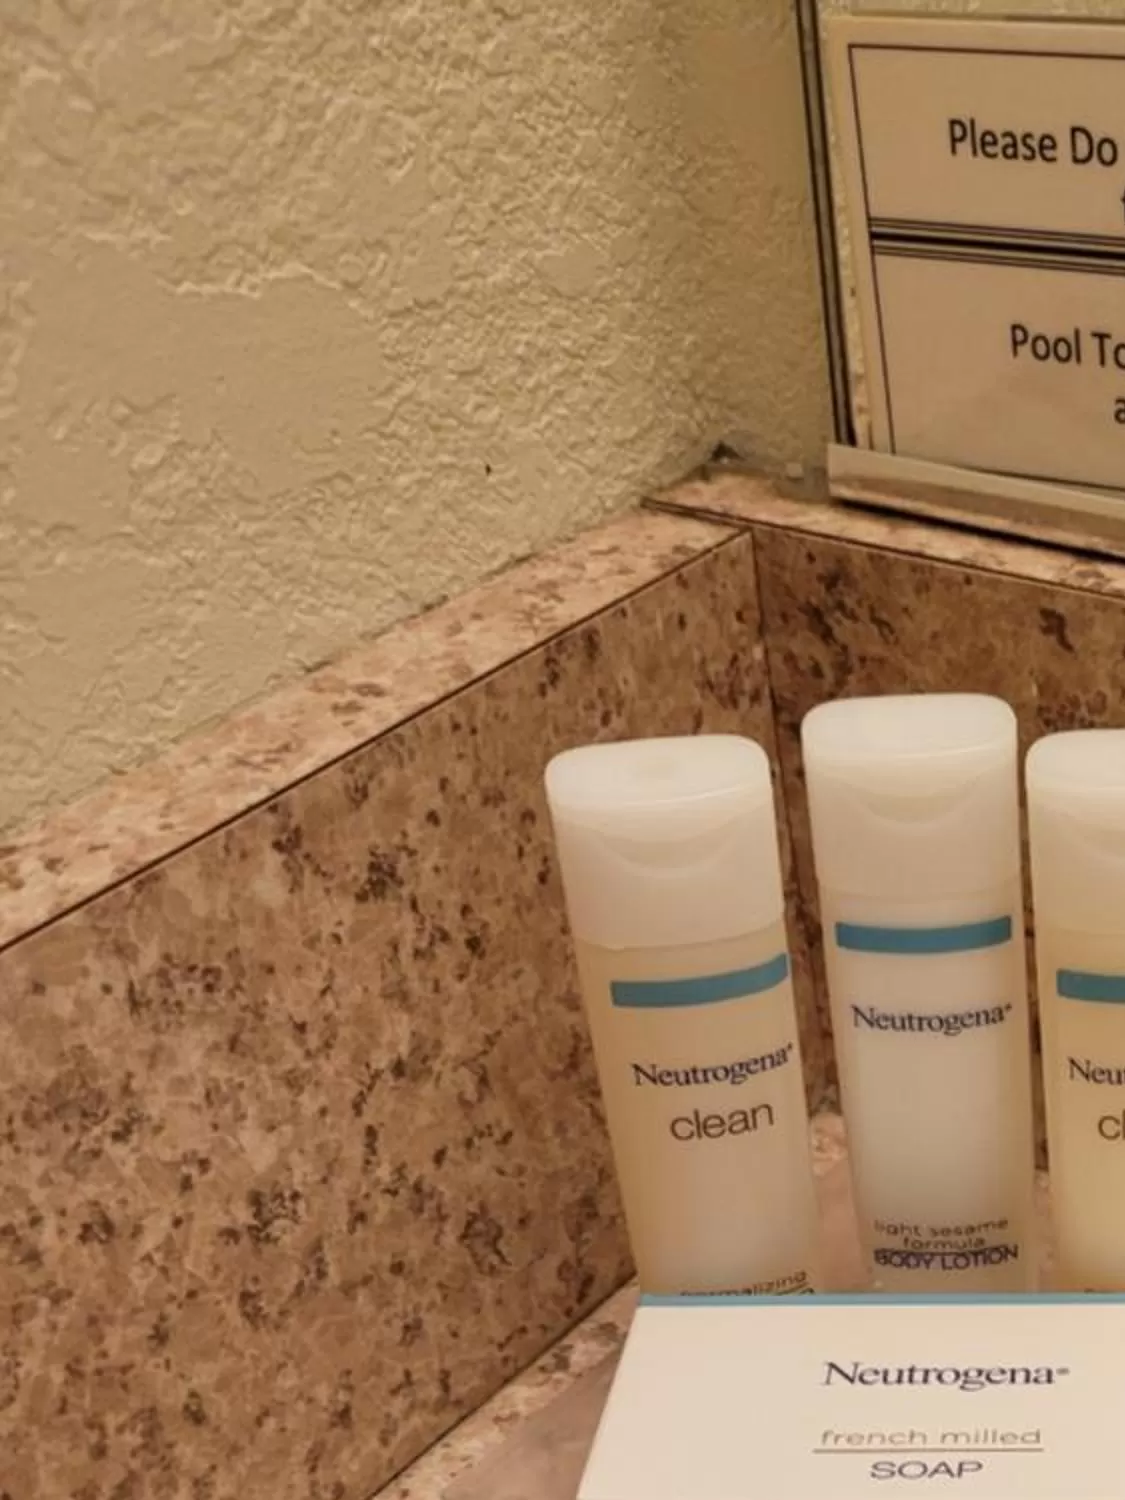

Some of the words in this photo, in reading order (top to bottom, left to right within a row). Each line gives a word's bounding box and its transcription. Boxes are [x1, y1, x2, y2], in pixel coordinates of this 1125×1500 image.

[948, 119, 1058, 164] Please
[1069, 126, 1120, 168] Do
[1011, 324, 1082, 365] Pool
[669, 1102, 774, 1142] clean
[903, 1236, 985, 1250] formula
[873, 1248, 934, 1270] BODY
[940, 1244, 1019, 1271] LOTION
[820, 1429, 927, 1446] french
[939, 1429, 1041, 1446] milled
[869, 1461, 984, 1480] SOAP
